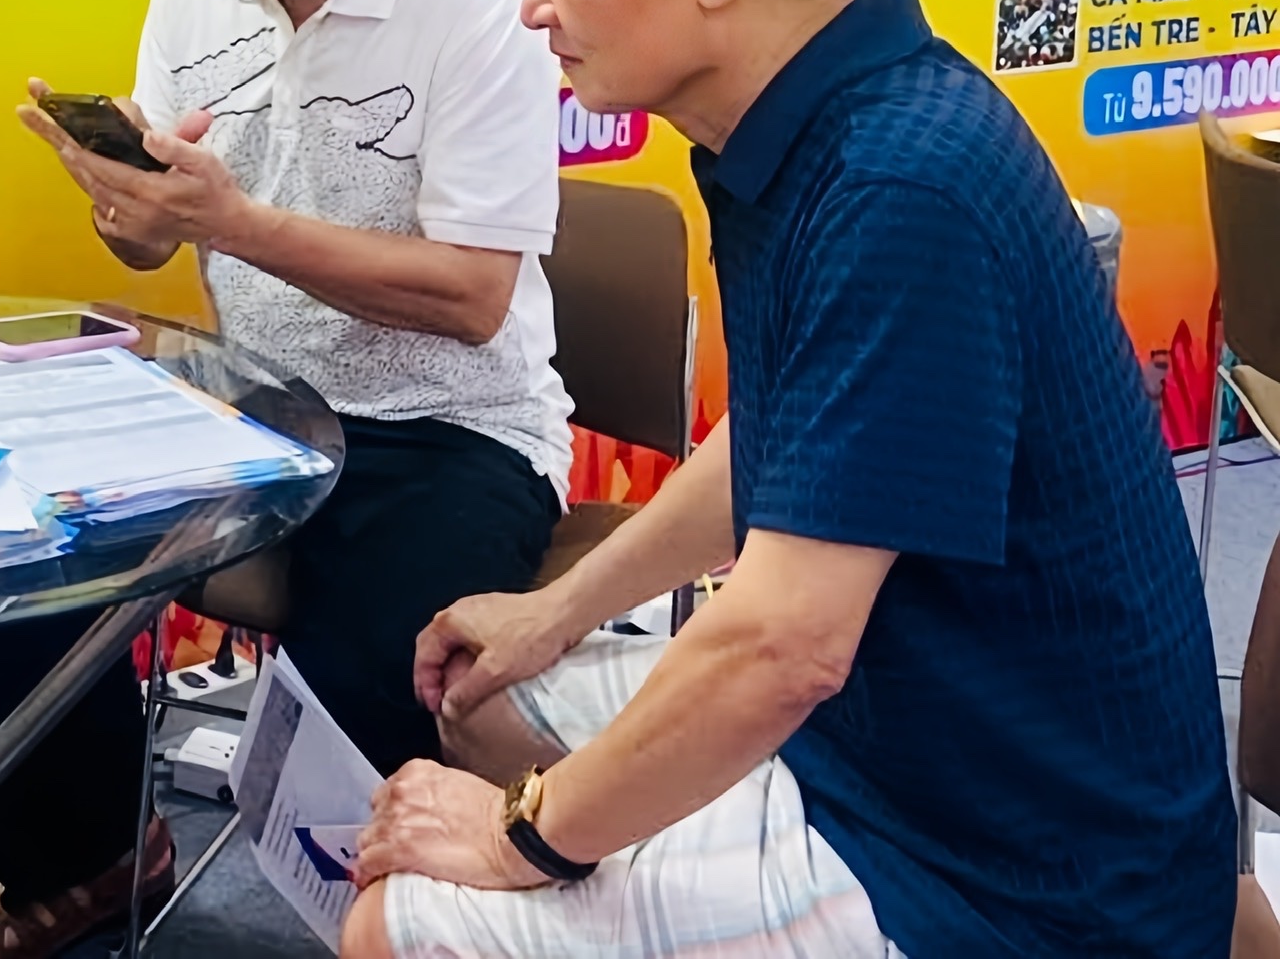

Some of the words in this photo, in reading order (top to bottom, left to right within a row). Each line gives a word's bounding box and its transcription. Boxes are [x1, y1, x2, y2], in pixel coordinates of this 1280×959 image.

[1087, 13, 1143, 53] BẾN
[1151, 17, 1200, 46] TRE
[1231, 3, 1278, 38] TÂY
